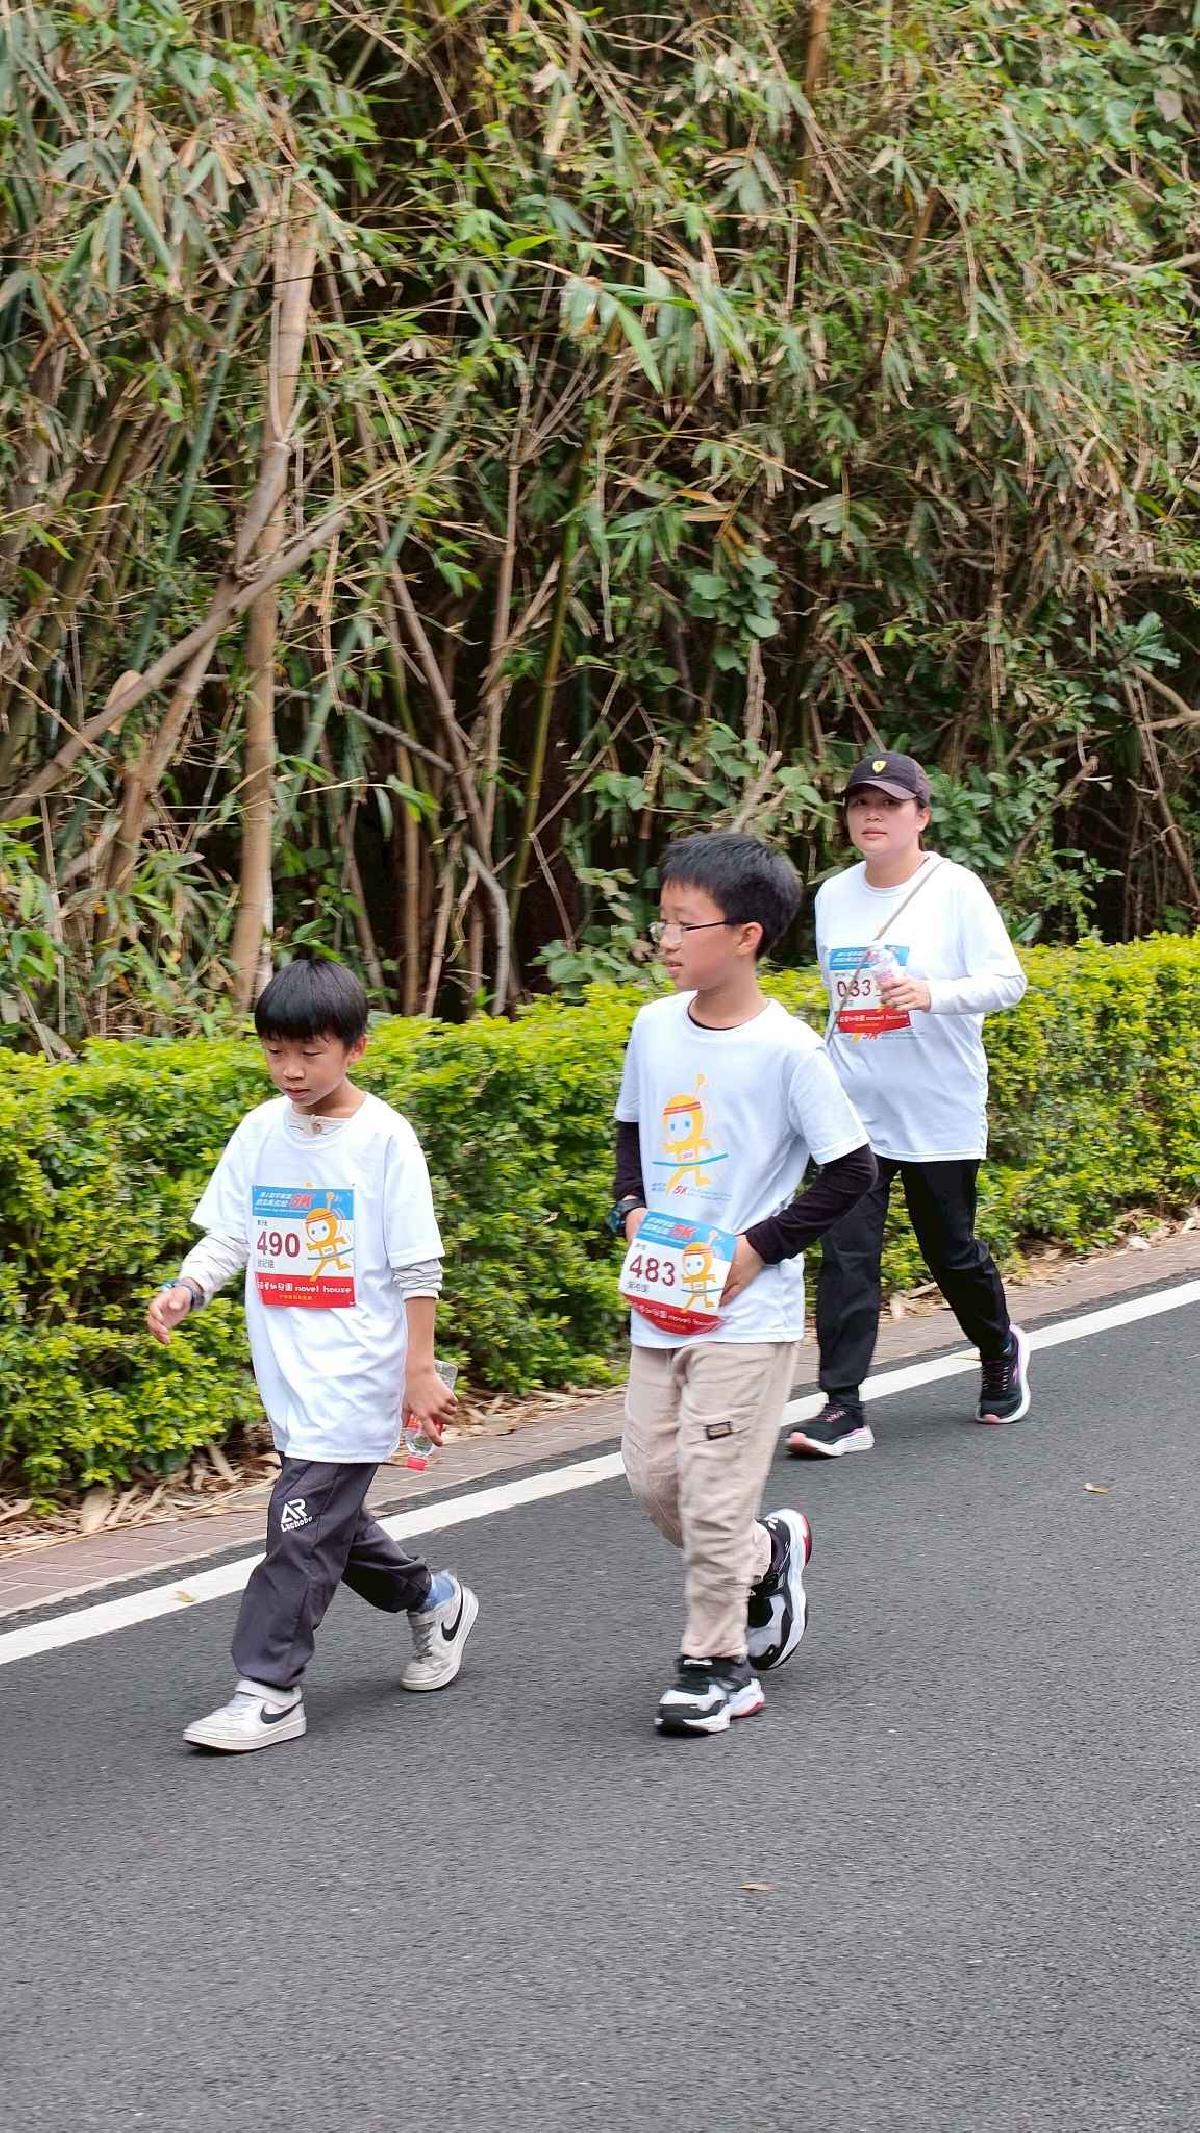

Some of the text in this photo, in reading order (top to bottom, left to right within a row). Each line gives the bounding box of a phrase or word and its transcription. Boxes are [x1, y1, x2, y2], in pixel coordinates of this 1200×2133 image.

[256, 1230, 301, 1258] 490
[629, 1254, 676, 1287] 483
[322, 1283, 353, 1294] house
